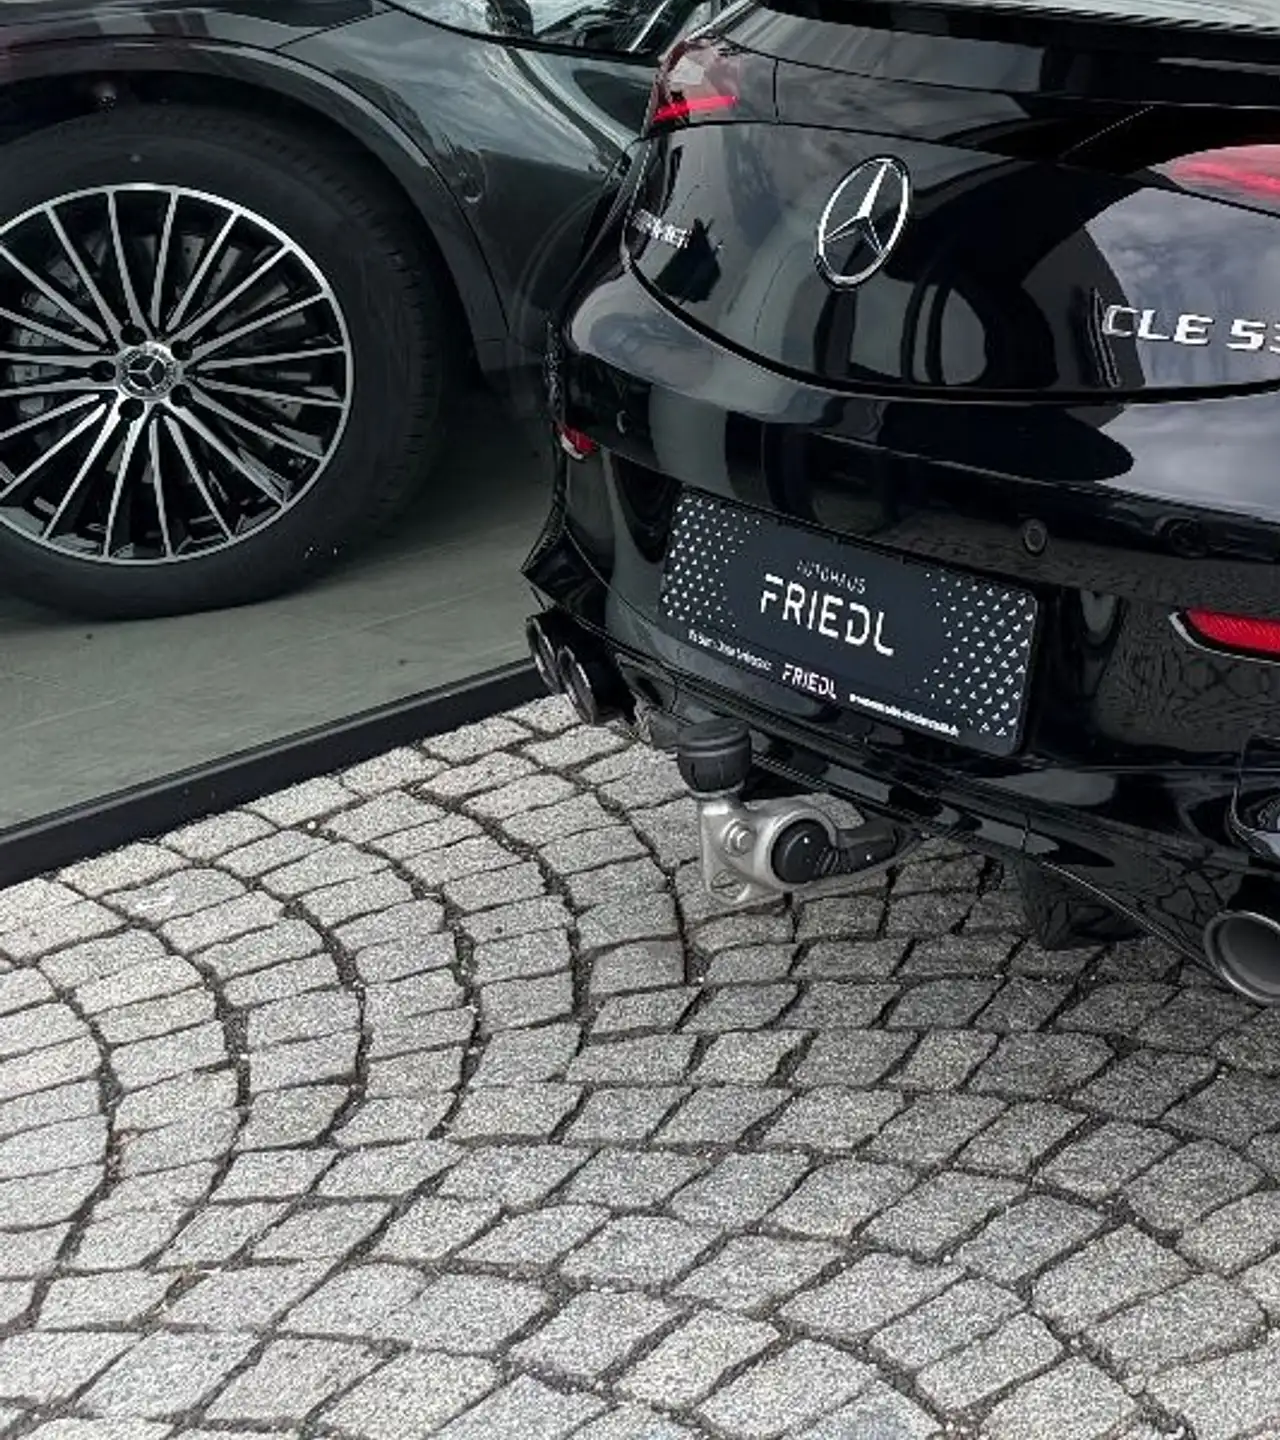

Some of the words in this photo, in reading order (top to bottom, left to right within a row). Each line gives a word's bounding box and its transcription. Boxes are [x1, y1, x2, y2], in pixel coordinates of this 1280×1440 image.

[1102, 304, 1216, 346] CLE
[760, 573, 894, 657] FRIEDL
[782, 662, 837, 700] FRIEDL
